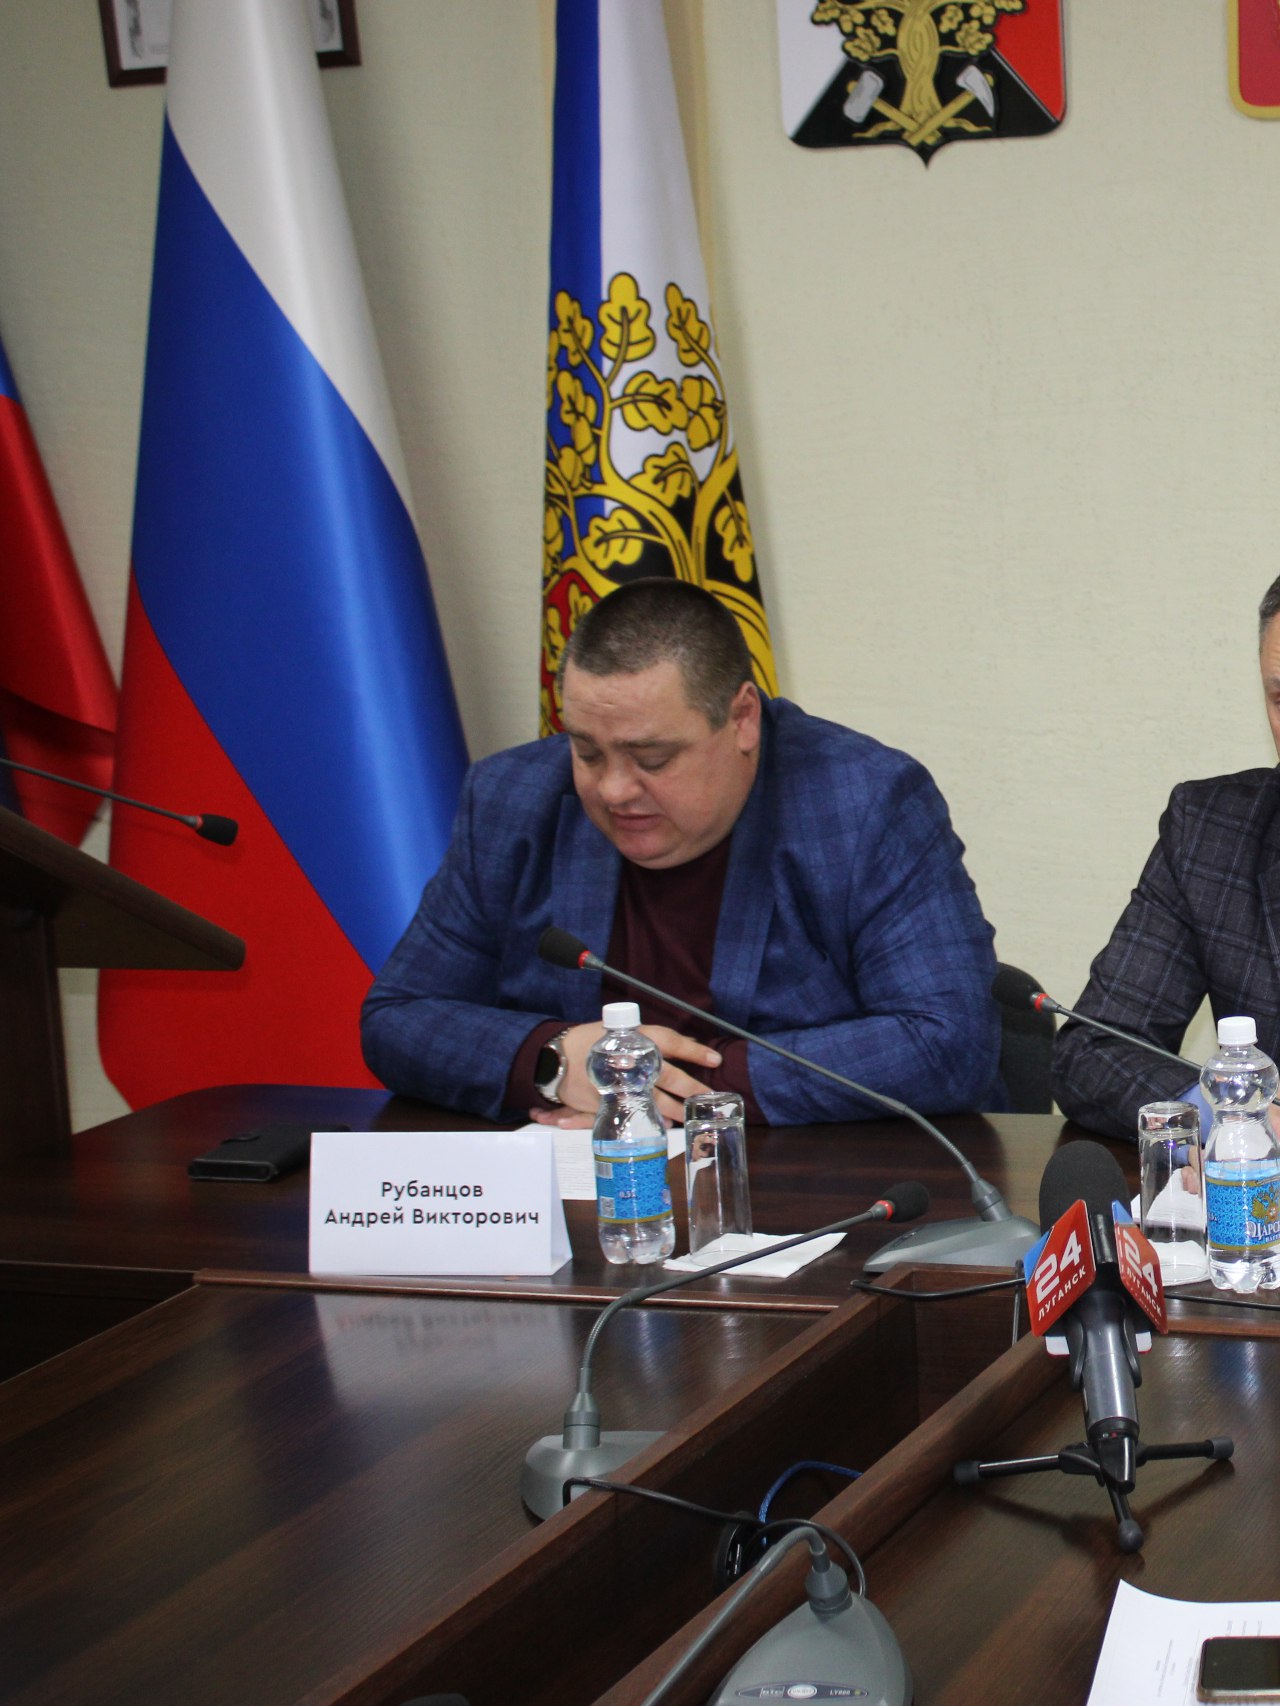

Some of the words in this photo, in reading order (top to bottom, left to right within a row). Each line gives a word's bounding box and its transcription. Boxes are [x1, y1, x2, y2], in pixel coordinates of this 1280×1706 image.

[381, 1180, 483, 1201] Рубанцов
[324, 1207, 404, 1228] Андрей
[412, 1208, 539, 1228] Викторович
[1034, 1230, 1082, 1304] 24
[1123, 1229, 1158, 1298] 24
[1038, 1265, 1087, 1321] ЛУГАНСК
[1127, 1266, 1162, 1317] ЛУГАНСК
